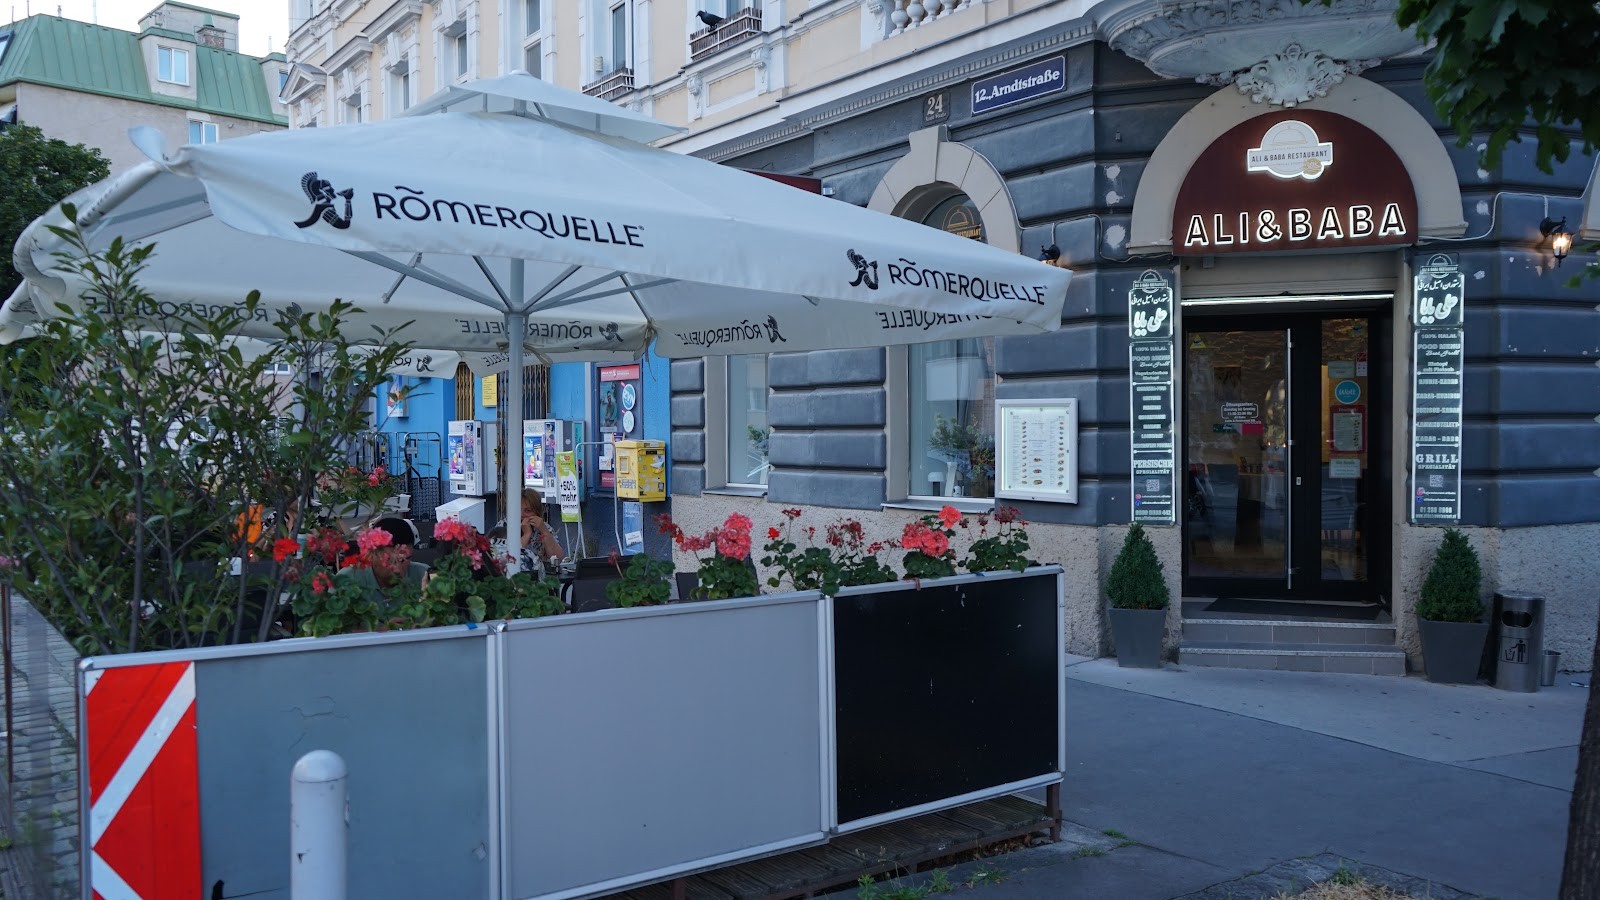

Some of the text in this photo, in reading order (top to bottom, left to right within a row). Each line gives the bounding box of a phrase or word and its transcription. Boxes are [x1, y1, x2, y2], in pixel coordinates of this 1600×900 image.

[991, 70, 1060, 98] Arndtstraße
[927, 94, 943, 116] 24
[1287, 150, 1328, 160] RESTAURANT
[1416, 454, 1458, 463] GRILL
[1134, 460, 1172, 468] PERSISCHE
[560, 480, 576, 491] +50%
[561, 493, 576, 502] mehr
